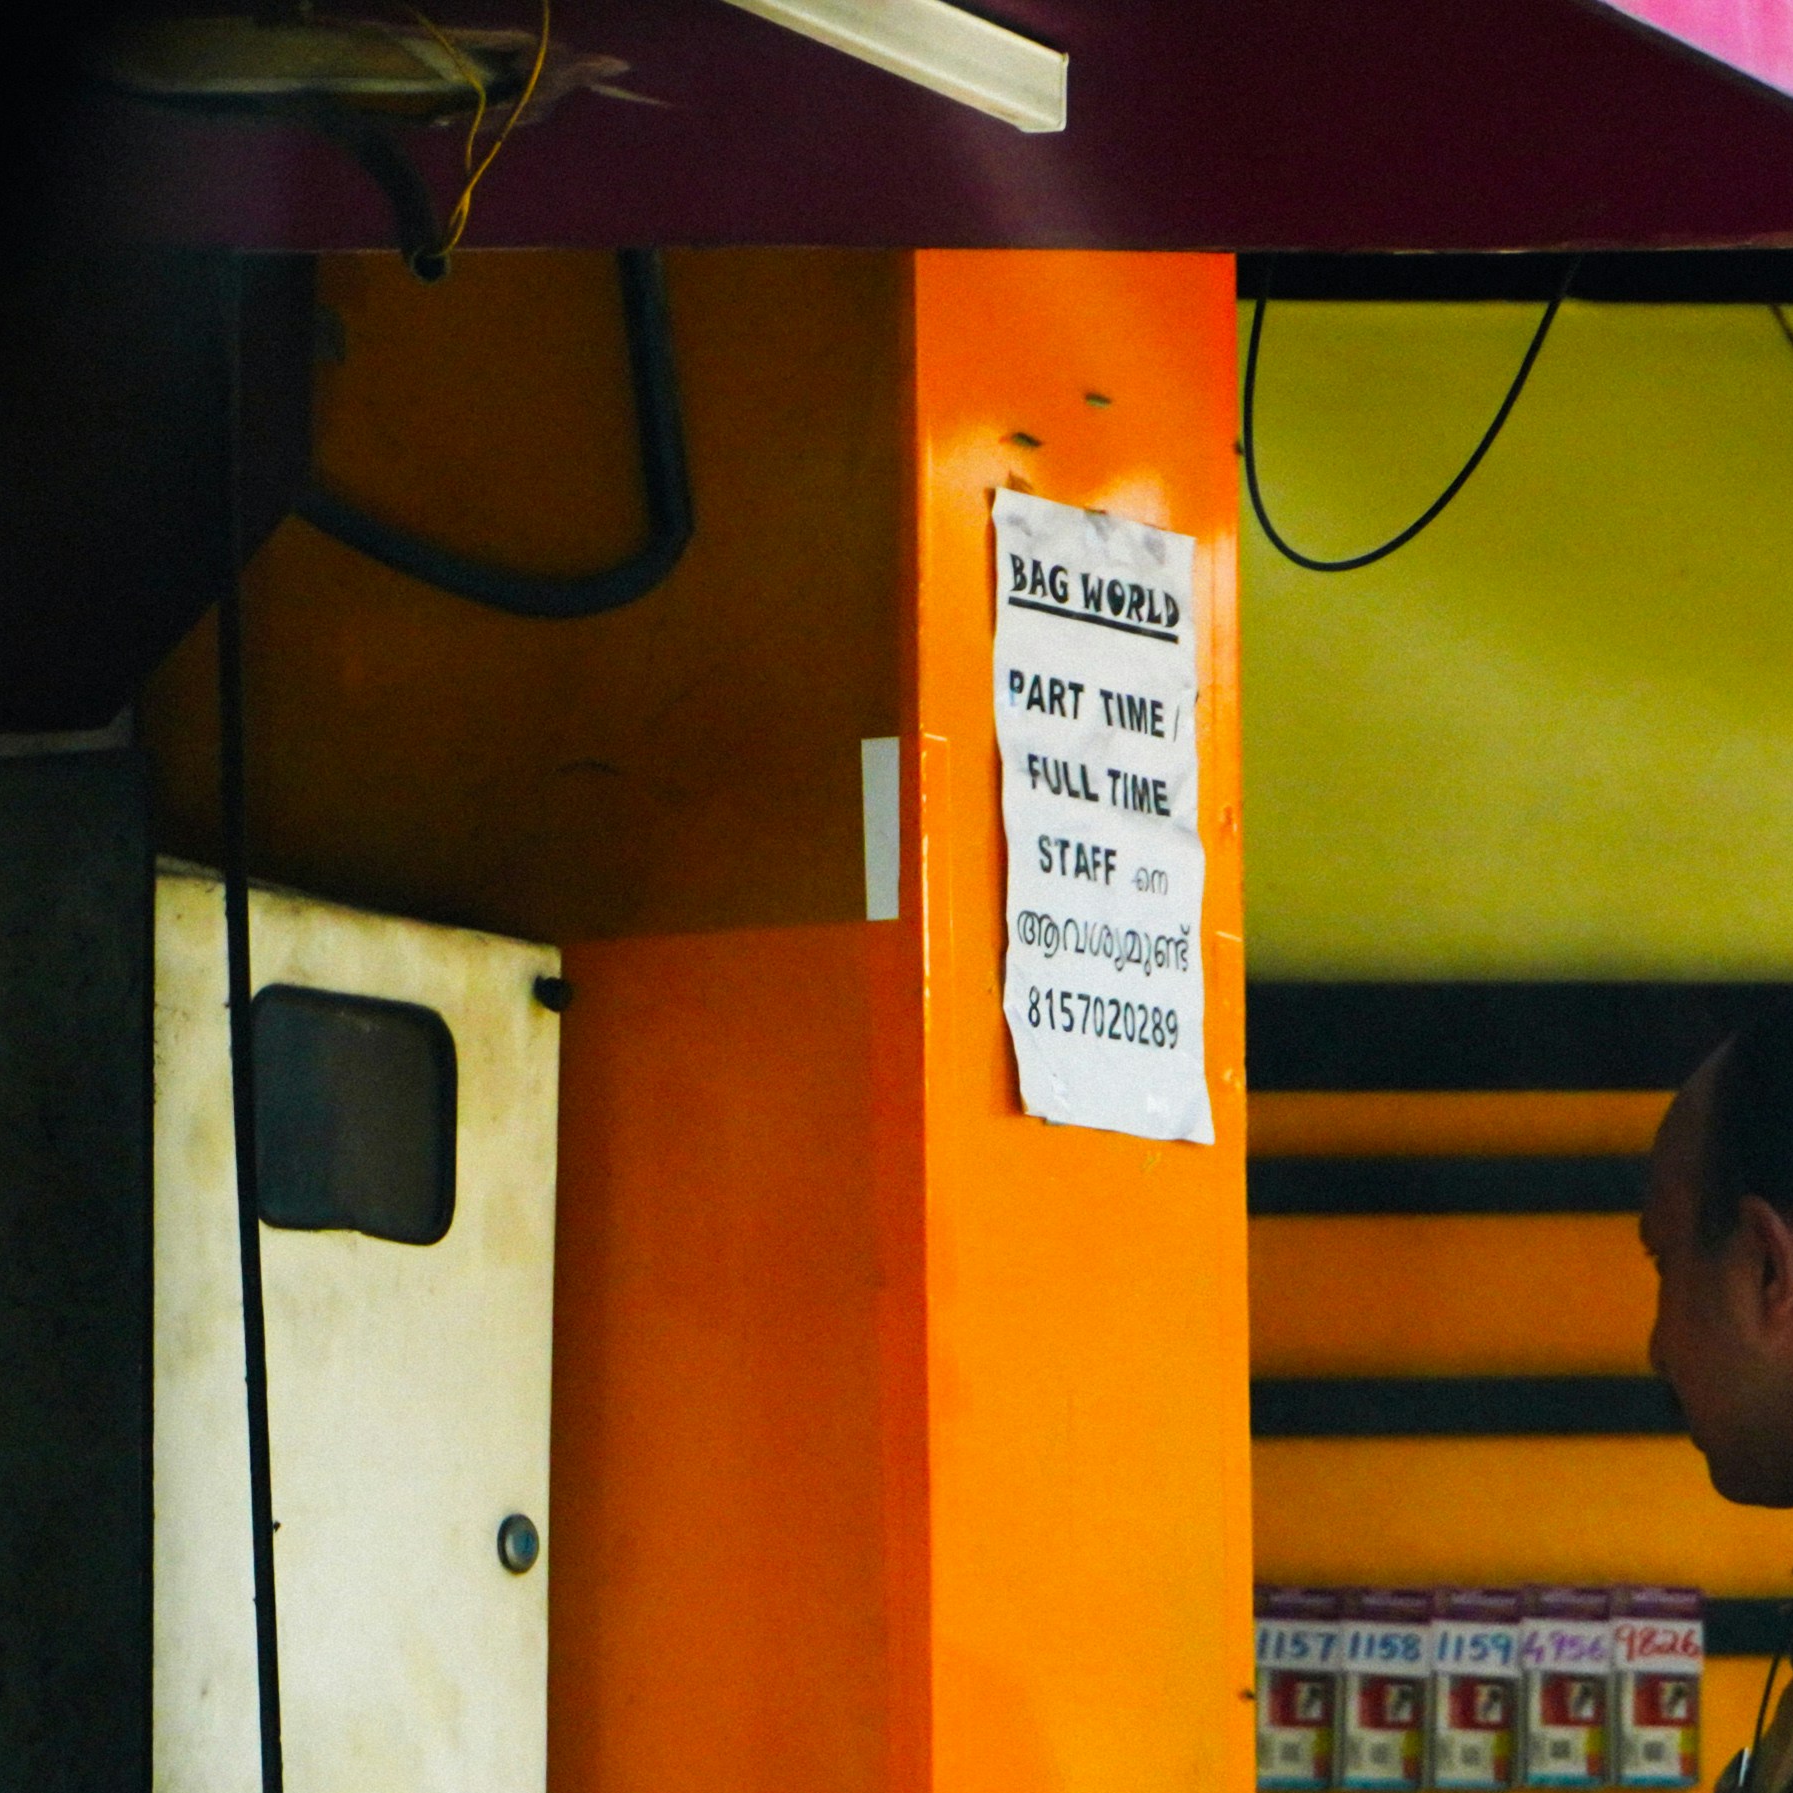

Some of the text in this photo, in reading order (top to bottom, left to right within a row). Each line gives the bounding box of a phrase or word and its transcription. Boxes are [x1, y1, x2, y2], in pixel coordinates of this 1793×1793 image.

[1009, 553, 1180, 628] BAG WORLD
[1009, 669, 1084, 720] PART
[1099, 688, 1165, 738] TIME
[1028, 753, 1170, 817] FULL TIME
[1038, 832, 1116, 886] STAFF
[1028, 985, 1179, 1050] 8157020289
